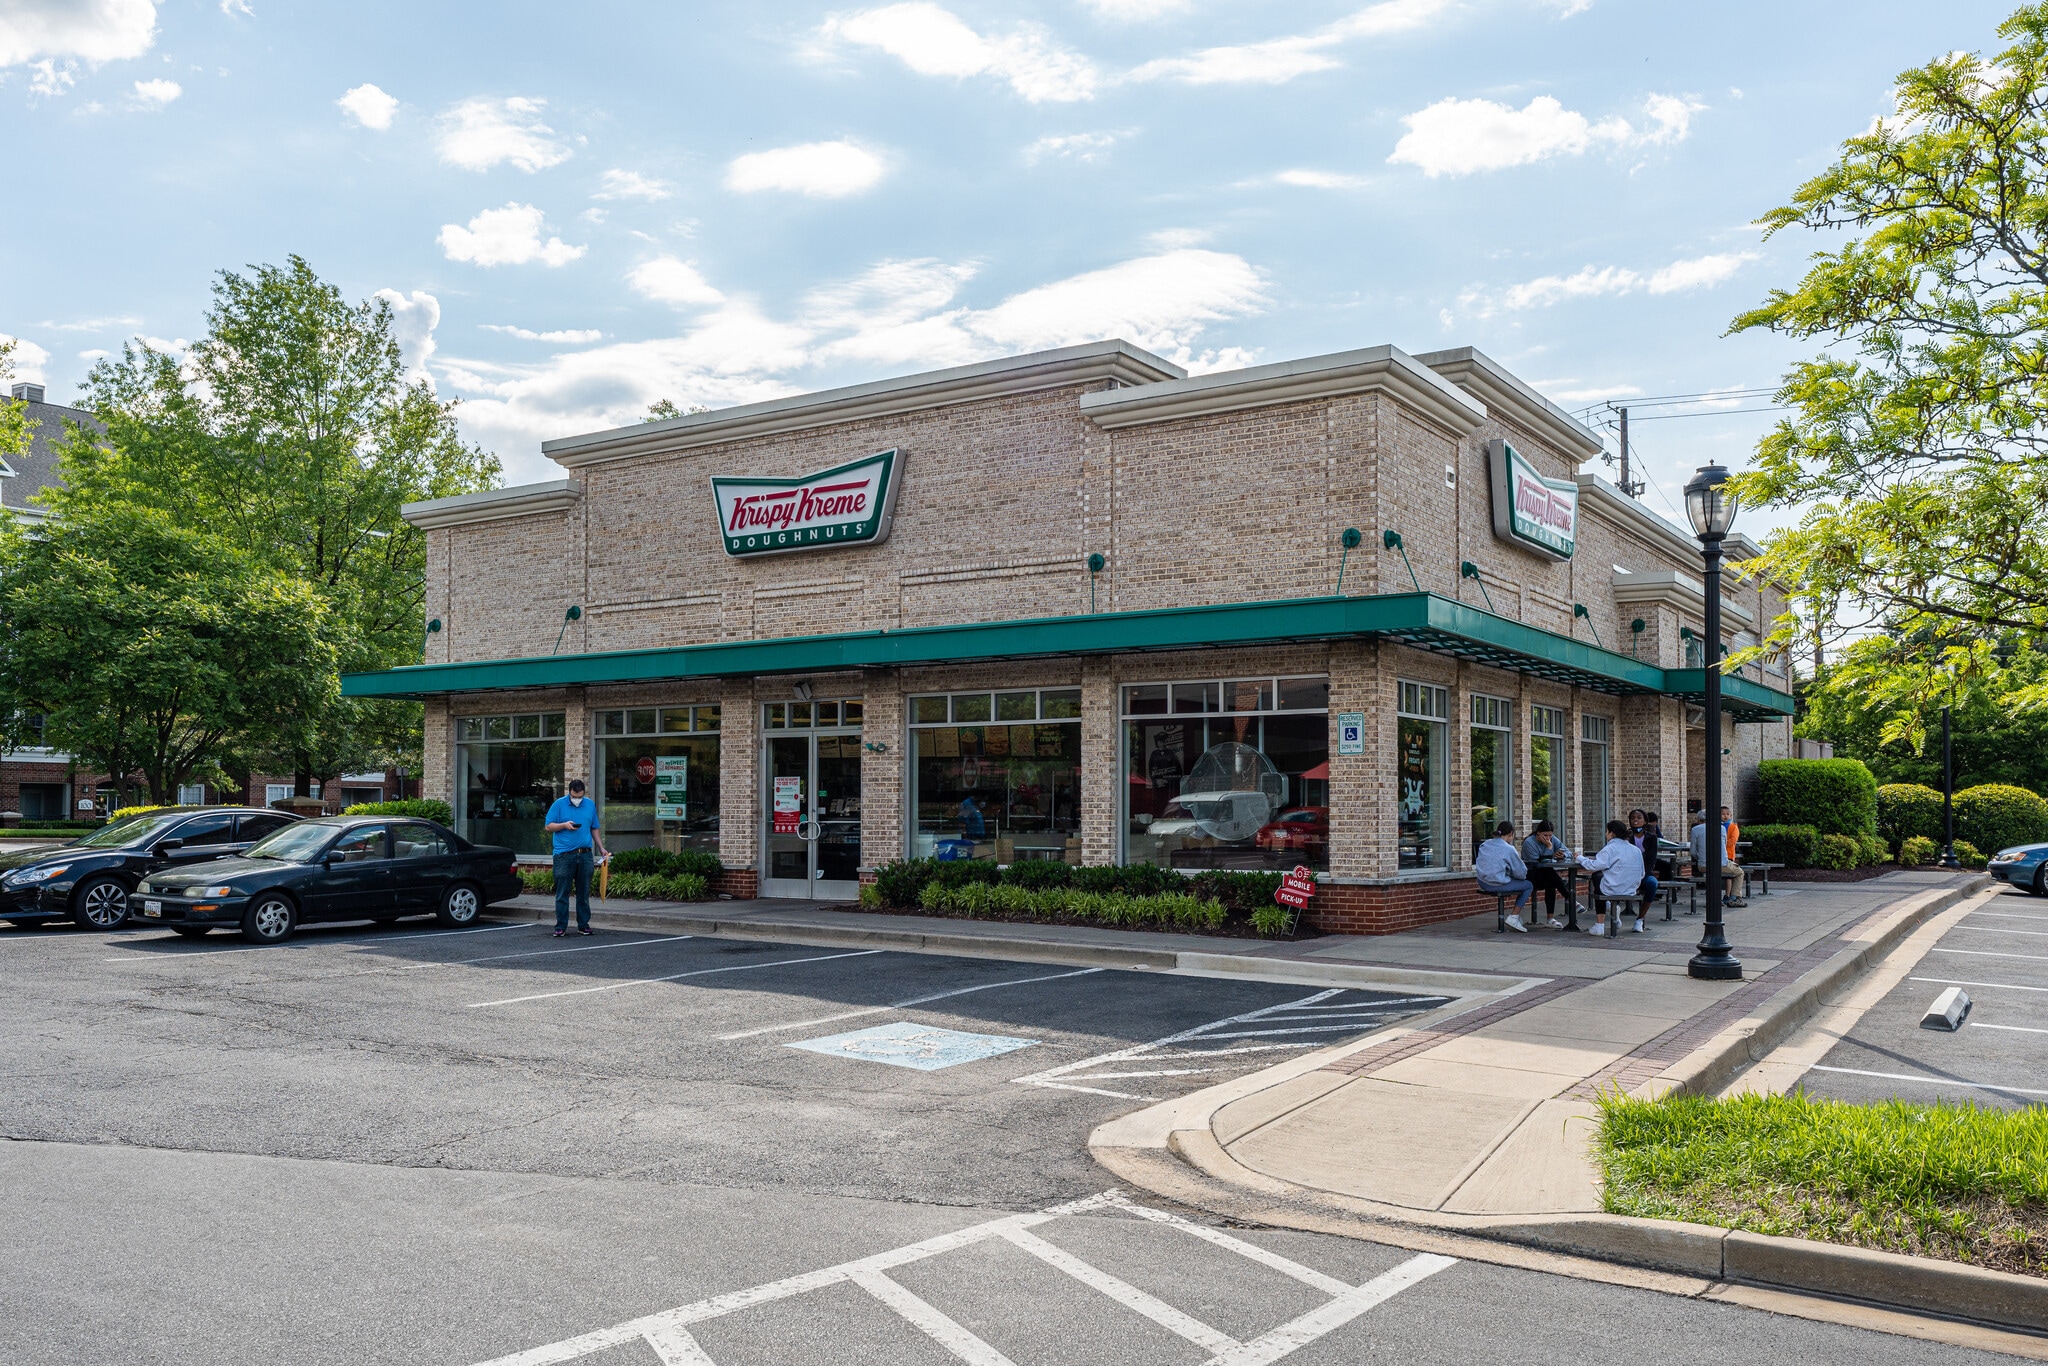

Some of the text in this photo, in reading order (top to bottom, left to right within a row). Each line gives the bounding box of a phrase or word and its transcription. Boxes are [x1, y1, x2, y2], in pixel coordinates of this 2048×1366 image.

[729, 478, 871, 531] Krispy Kreme
[1516, 475, 1572, 532] Krispy Kreme
[733, 523, 863, 549] DOUGHNUTS
[1288, 879, 1311, 891] MOBILE
[1281, 893, 1304, 905] PICK-UP
